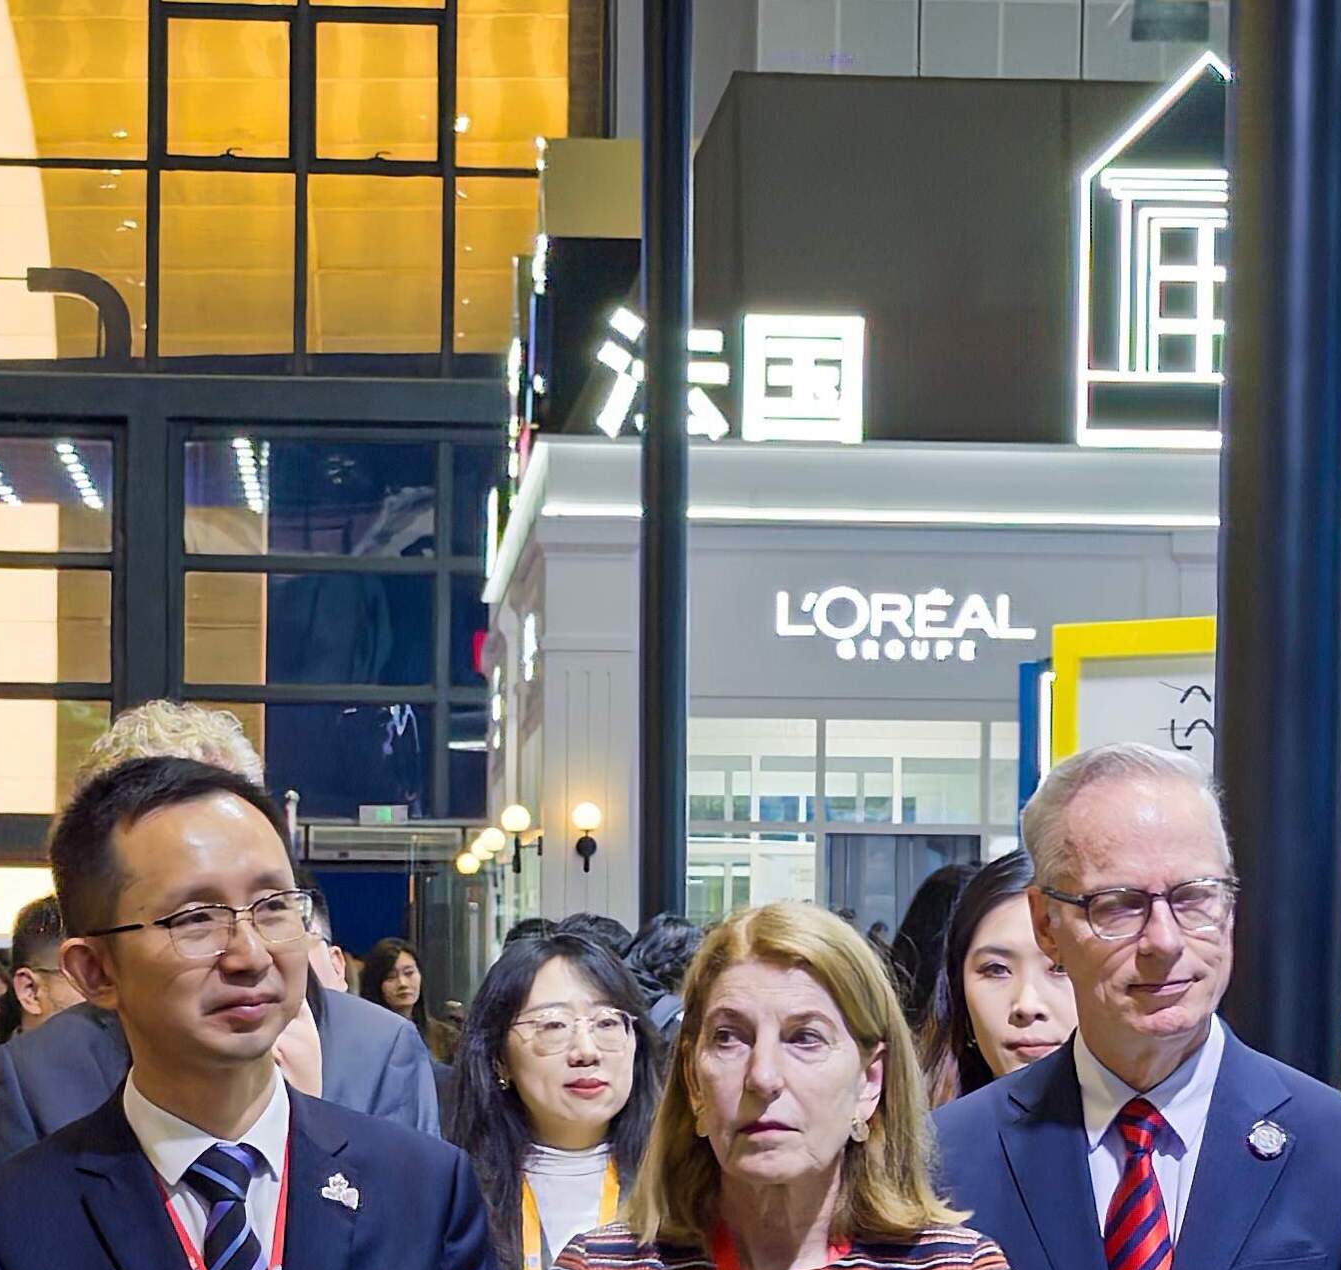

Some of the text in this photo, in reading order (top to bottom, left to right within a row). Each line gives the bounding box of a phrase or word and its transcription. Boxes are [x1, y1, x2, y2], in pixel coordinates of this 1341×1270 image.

[597, 307, 865, 443] 法国
[776, 586, 1037, 640] L'ORÉAL
[836, 638, 977, 662] GROUPE
